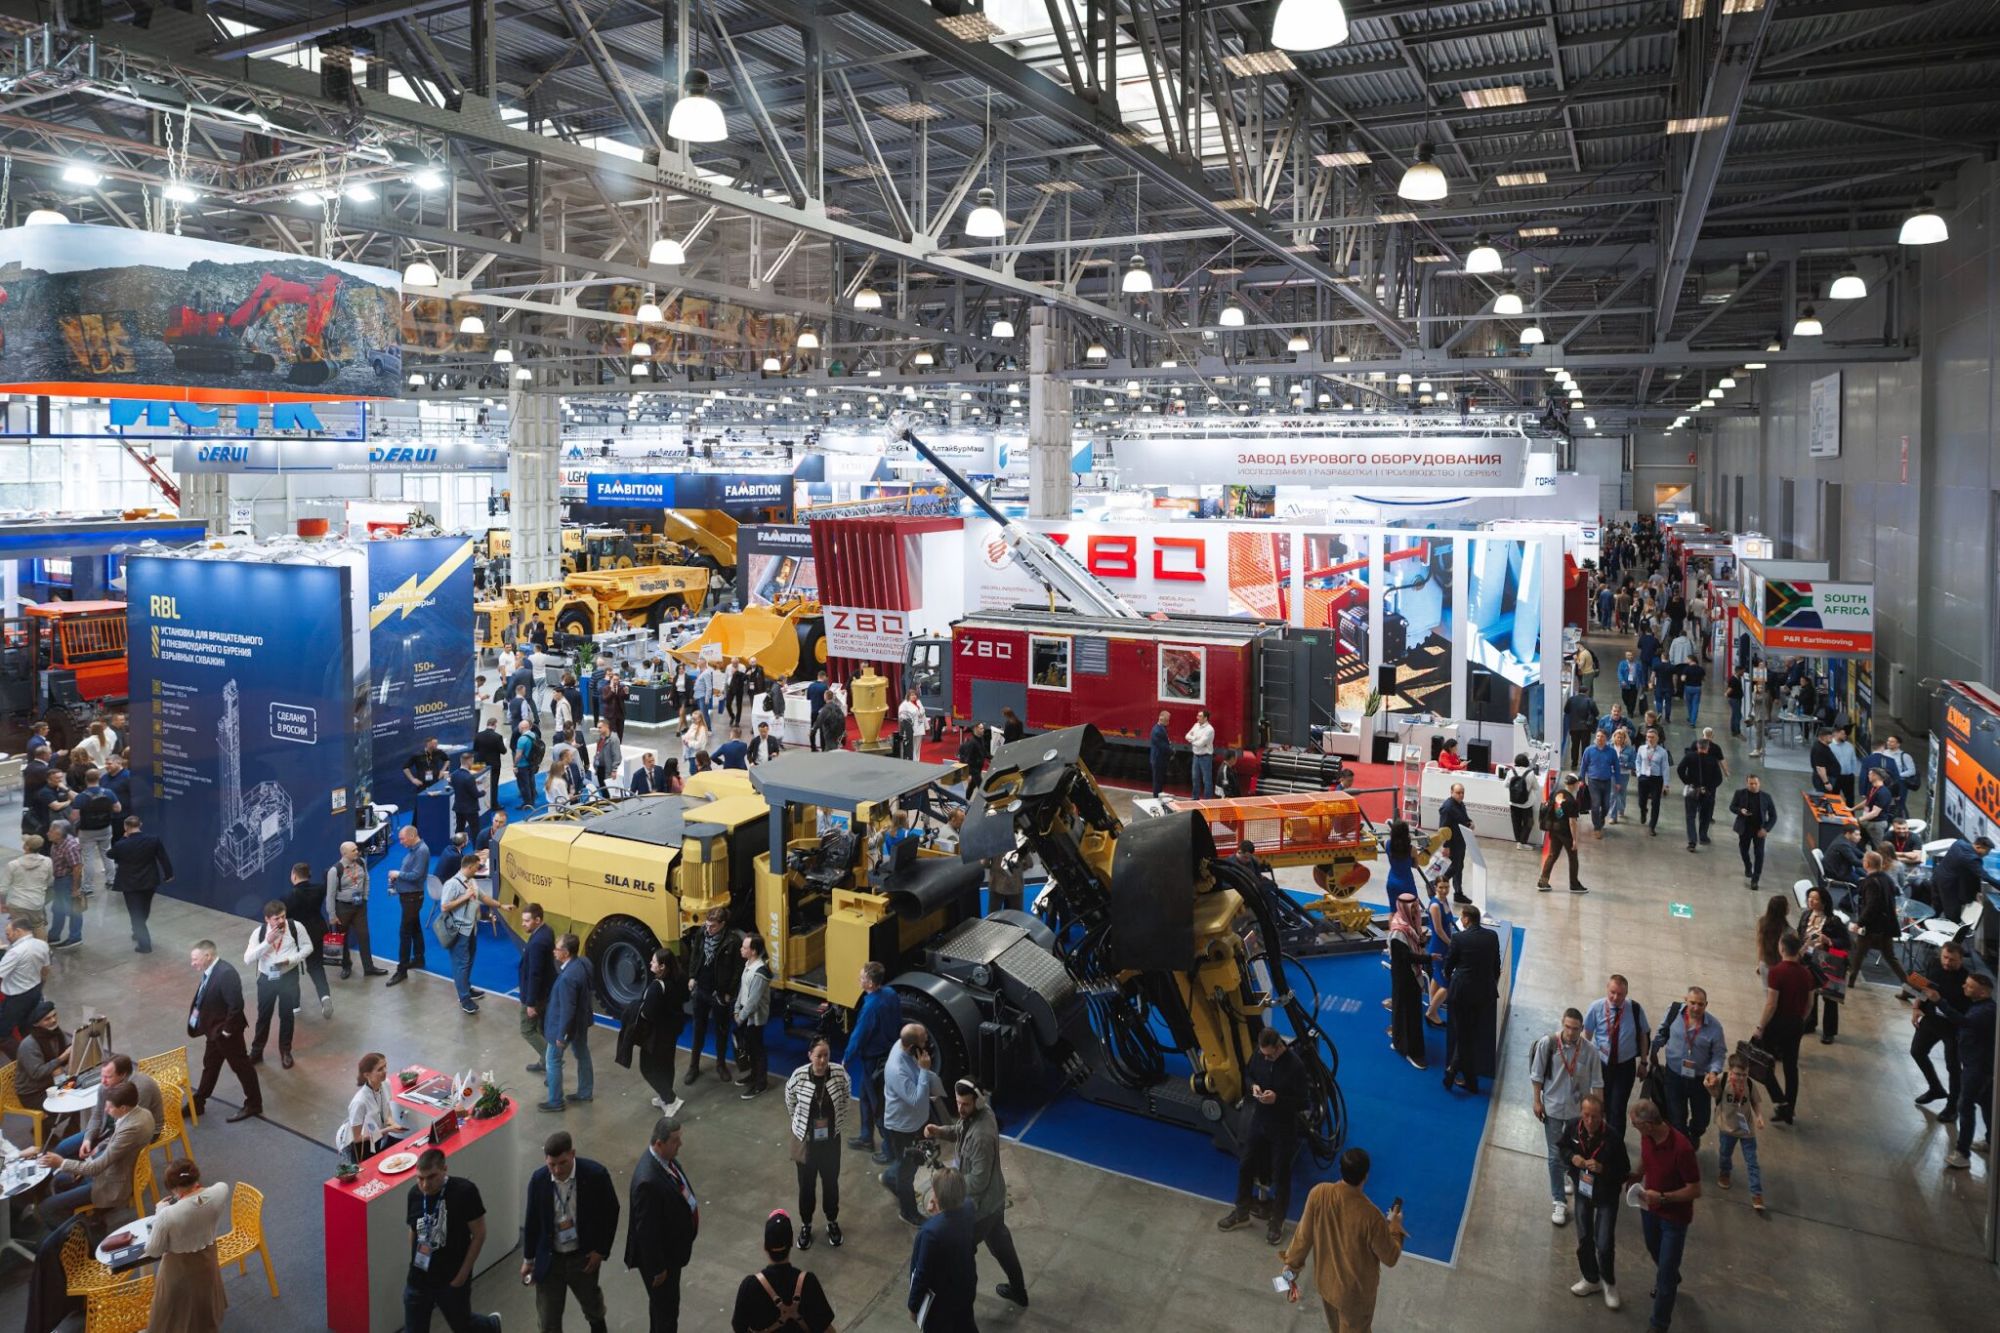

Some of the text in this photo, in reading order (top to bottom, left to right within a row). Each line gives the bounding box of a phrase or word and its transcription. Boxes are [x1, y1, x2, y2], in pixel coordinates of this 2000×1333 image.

[199, 447, 249, 462] DERUI
[369, 447, 437, 463] DERUI
[931, 445, 985, 454] АлтайБурМаш
[1238, 454, 1502, 465] ЗАВОД БУРОВОГО ОБОРУДОВАНИЯ
[1238, 468, 1306, 476] ИССЛЕДОВАНИЯ
[1314, 468, 1372, 476] РАЗРАБОТКИ
[1380, 469, 1455, 477] ПРОИЗВОДСТВО
[597, 480, 663, 496] FAMBITION
[725, 480, 781, 496] FAMBITION
[1043, 533, 1206, 583] BO
[1824, 593, 1867, 604] SOUTH
[150, 595, 181, 619] RBL
[1824, 605, 1870, 616] AFRICA
[160, 626, 264, 646] УСТАНОВКА ДЛЯ ВРАЩАТЕЛЬНОГО
[1802, 635, 1854, 647] Earthmoving
[161, 638, 252, 657] И ПНЕВМОУДАРНОГО БУРЕНИЯ
[161, 651, 226, 667] ВЗРЫВНЫХ СКВАЖИН
[414, 661, 436, 672] 150+
[414, 701, 448, 715] 10000+
[276, 711, 307, 724] СДЕЛАНО
[277, 723, 308, 737] В РОССИИ
[604, 873, 655, 893] SILA RL6
